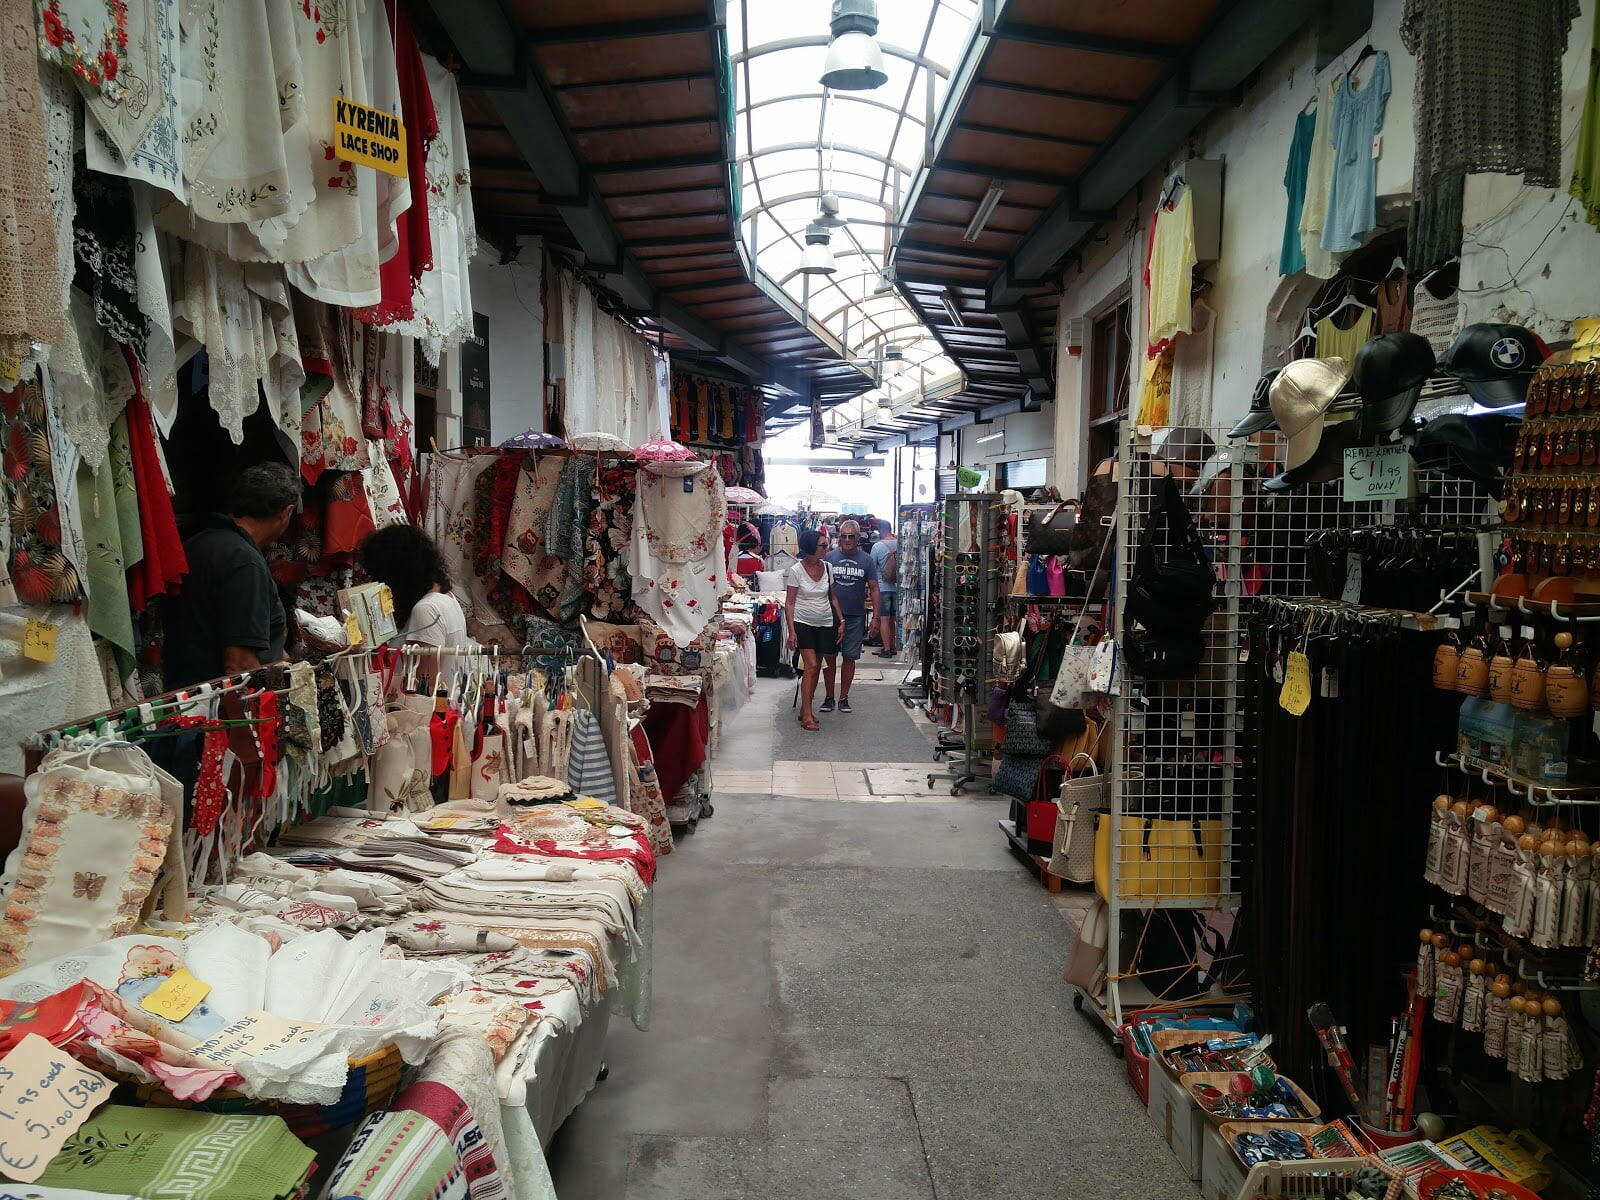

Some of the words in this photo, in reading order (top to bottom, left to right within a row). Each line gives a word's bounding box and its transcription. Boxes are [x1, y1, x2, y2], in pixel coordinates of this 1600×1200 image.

[337, 100, 400, 142] KYRENIA
[341, 131, 368, 155] LACE
[370, 141, 399, 164] SHOP
[206, 1033, 255, 1062] HANKIES
[280, 1026, 302, 1044] each
[39, 1060, 67, 1089] each
[0, 1141, 39, 1170] €
